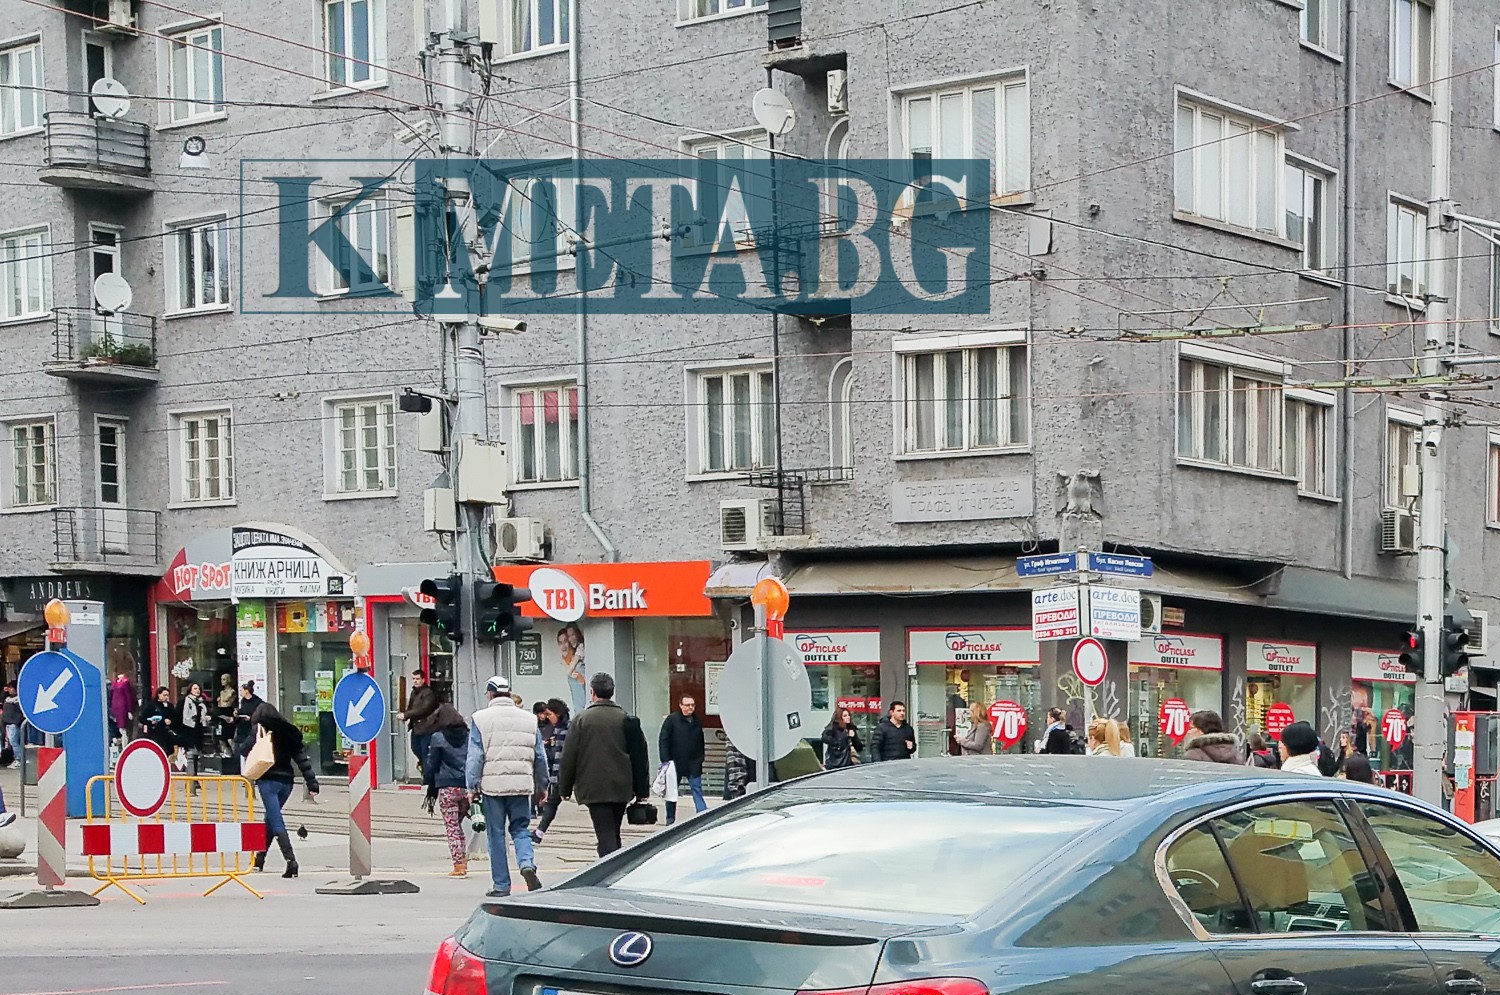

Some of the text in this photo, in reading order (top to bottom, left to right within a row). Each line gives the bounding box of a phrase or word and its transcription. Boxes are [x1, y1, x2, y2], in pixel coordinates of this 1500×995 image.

[234, 560, 320, 580] КНИЖАРНИЦА
[175, 564, 230, 592] HOT SPOT
[30, 581, 91, 600] ANDREWS
[300, 585, 321, 594] ФИЛМИ
[543, 582, 648, 610] TBI Bank
[1034, 589, 1076, 604] arte.doc
[1092, 590, 1138, 604] arte.doc
[1035, 609, 1077, 624] ПРЕВОДИ
[1093, 609, 1138, 623] ПРЕВОДИ
[519, 650, 537, 660] 7500
[1161, 655, 1189, 665] OUTLET
[1383, 672, 1405, 680] OUTLET
